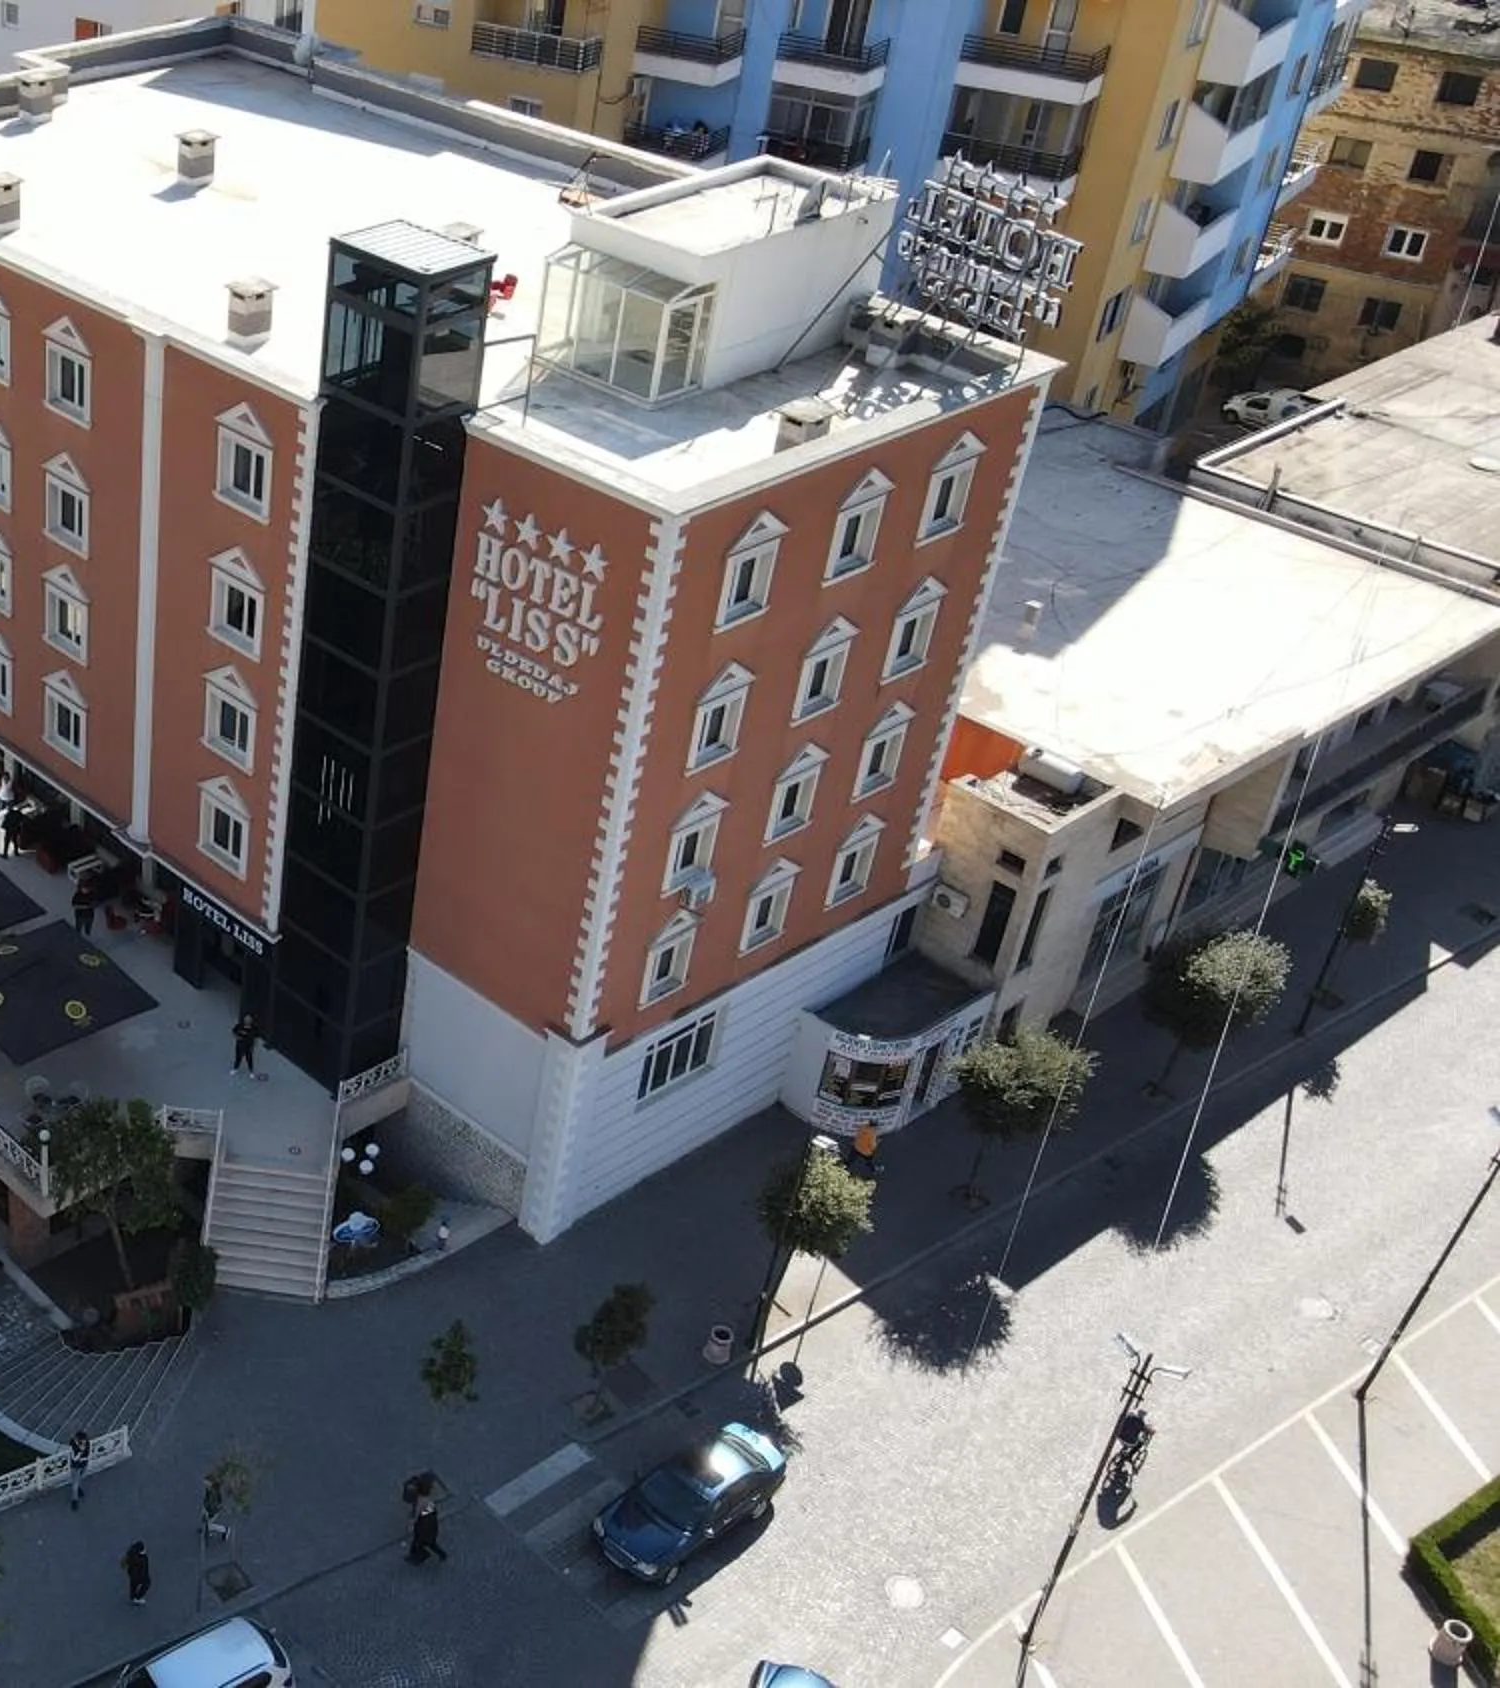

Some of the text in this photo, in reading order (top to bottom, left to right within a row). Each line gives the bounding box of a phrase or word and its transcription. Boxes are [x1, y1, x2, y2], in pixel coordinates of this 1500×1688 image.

[474, 531, 603, 631] HOTEL
[471, 577, 601, 667] "LISS"
[485, 658, 564, 704] GROUP
[182, 886, 264, 956] HOTEL LISS
